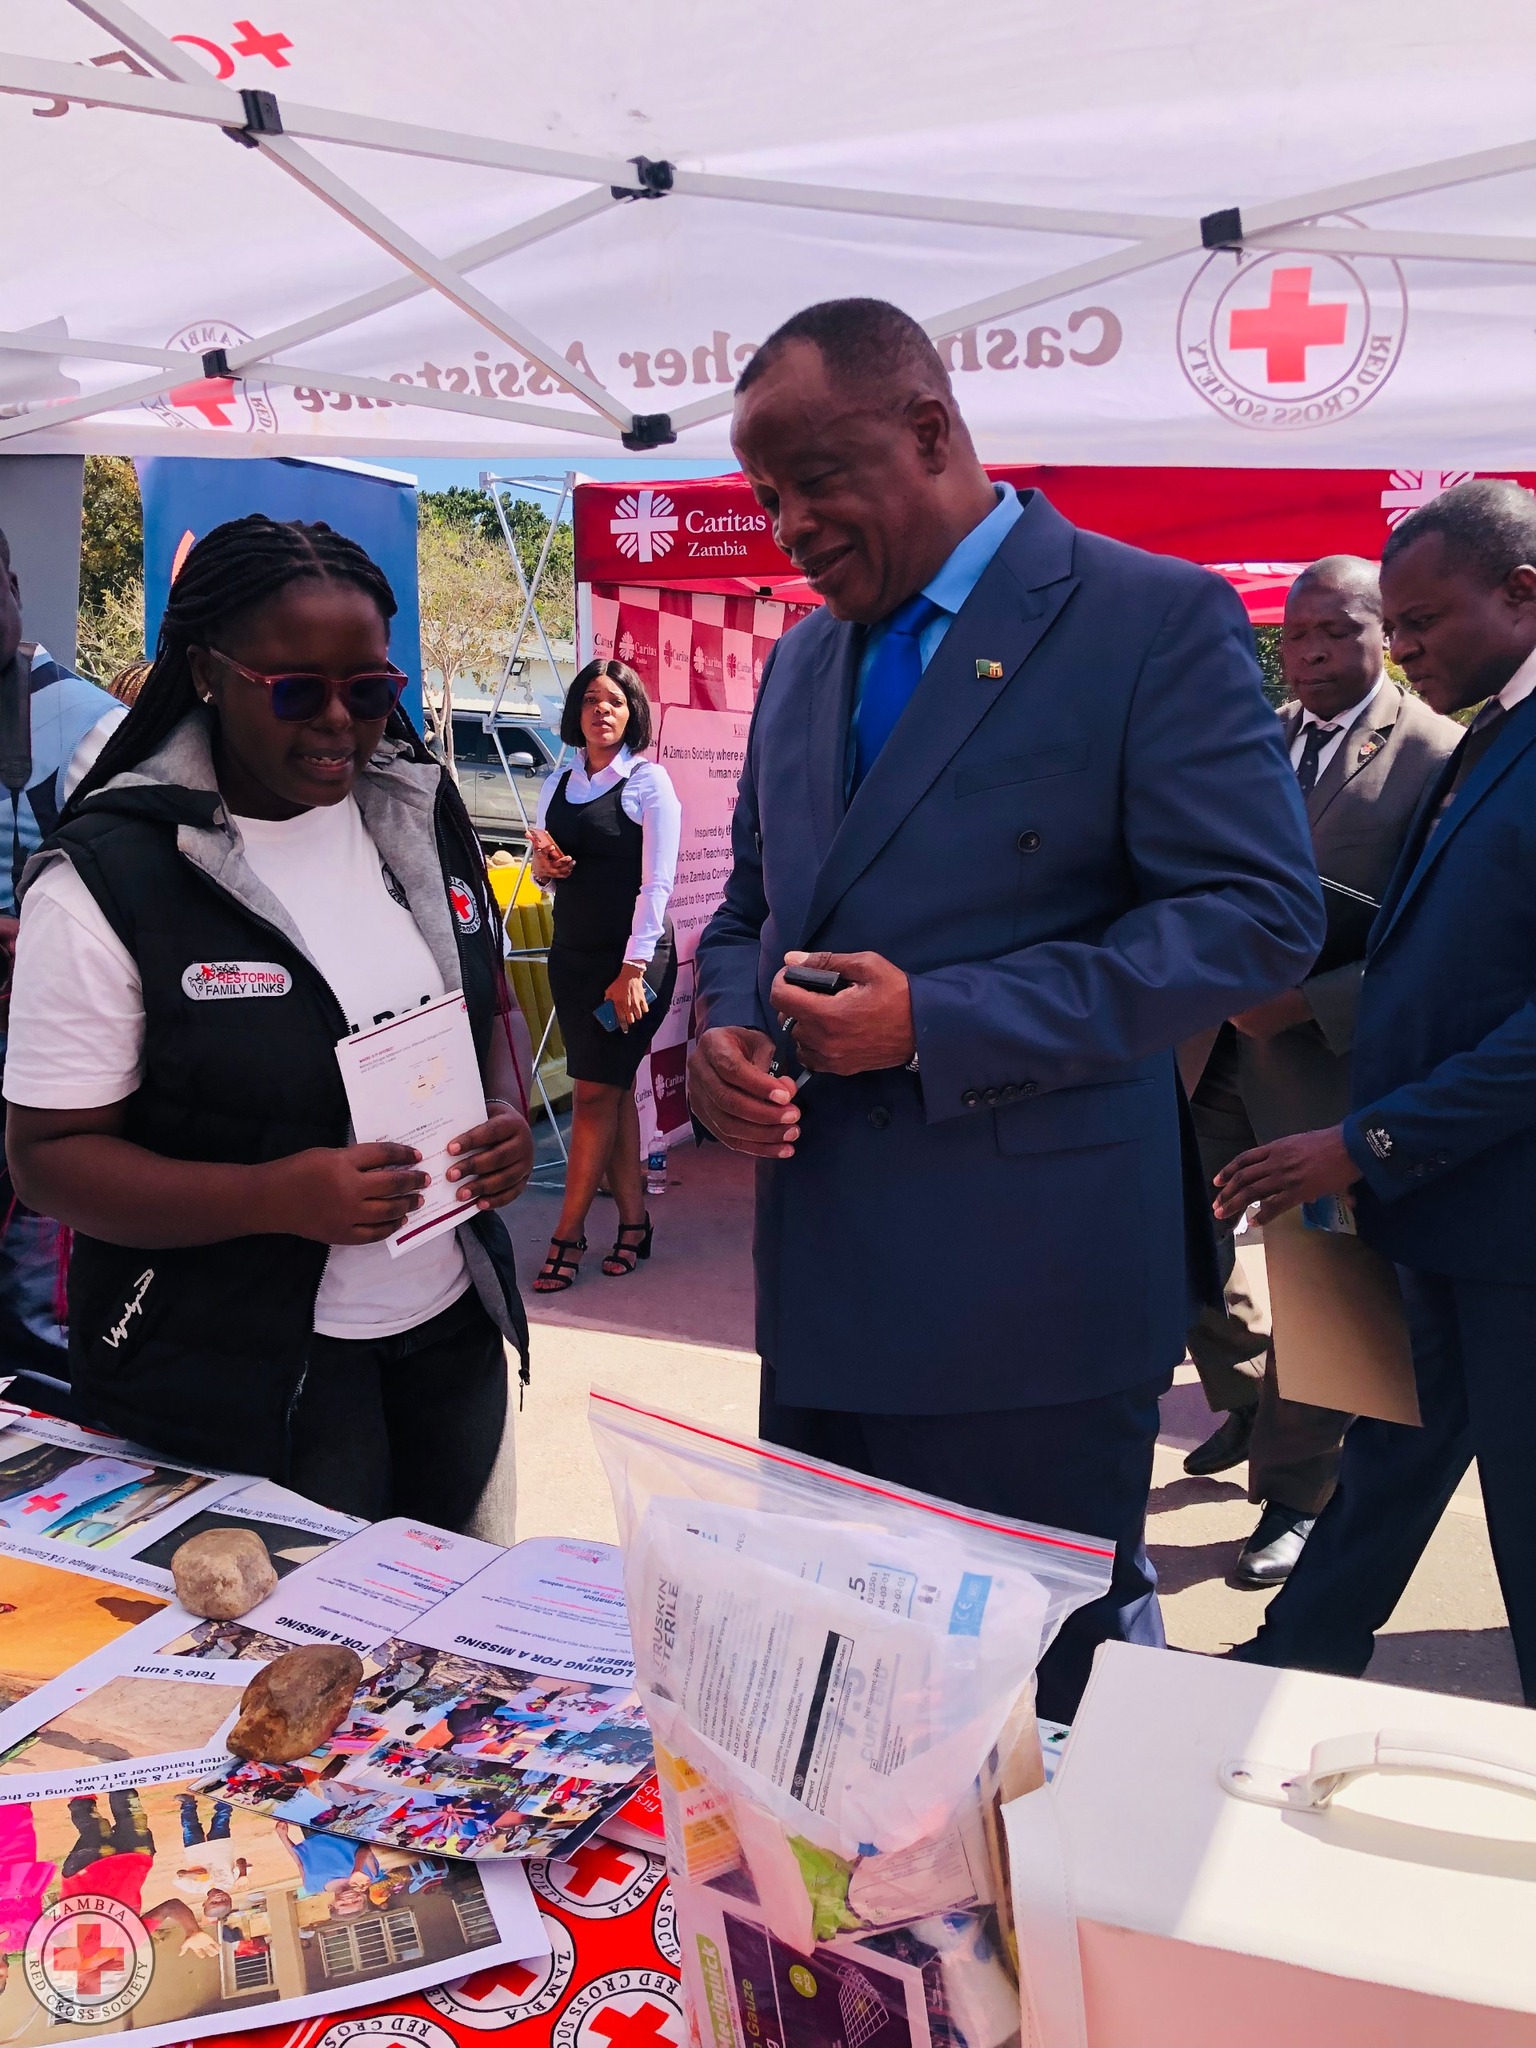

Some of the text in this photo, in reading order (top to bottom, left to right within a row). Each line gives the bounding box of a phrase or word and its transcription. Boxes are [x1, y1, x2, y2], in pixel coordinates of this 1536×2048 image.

[684, 509, 767, 535] Caritas
[687, 541, 748, 558] Zambia
[662, 745, 669, 758] A
[692, 747, 715, 763] Society
[716, 749, 739, 761] where
[709, 767, 732, 779] human
[694, 826, 725, 839] Inspired by
[685, 850, 702, 863] Social
[680, 873, 688, 885] the
[689, 870, 711, 883] Zambia
[712, 868, 732, 882] Confer
[688, 893, 704, 905] to the
[217, 973, 285, 985] RESTORING
[205, 983, 285, 996] FAMILY LINKS
[264, 1508, 295, 1525] phones
[295, 1516, 323, 1531] charge
[412, 1580, 449, 1597] formation
[582, 1593, 626, 1608] formation
[693, 1593, 703, 1625] GLOVES
[652, 1574, 667, 1666] TRUSKIN
[274, 1615, 370, 1653] FOR A MISSING
[658, 1582, 679, 1676] STERILE
[765, 1626, 777, 1654] systems
[453, 1634, 633, 1677] LOOKING FOR A MISSING
[586, 1654, 634, 1667] MBER?
[836, 1643, 847, 1667] broken
[133, 1665, 216, 1681] Tete's aunt
[777, 1718, 789, 1744] natural
[794, 1656, 805, 1677] which
[827, 1750, 837, 1769] Store
[839, 1681, 853, 1715] conditions
[198, 1755, 229, 1766] after
[749, 1746, 760, 1768] Gloves
[114, 1771, 126, 1780] at
[130, 1759, 196, 1777] handover
[101, 1775, 147, 1791] Sifa-17
[152, 1774, 161, 1783] &
[27, 1790, 41, 1799] to
[45, 1782, 95, 1797] waving
[531, 1863, 567, 1905] OCIETY
[505, 1951, 571, 2020] ZAMBIA
[794, 1971, 803, 1986] 10
[569, 1973, 679, 2017] RED CROSS
[743, 1979, 760, 2038] Gauze
[324, 2017, 432, 2048] RED CROS
